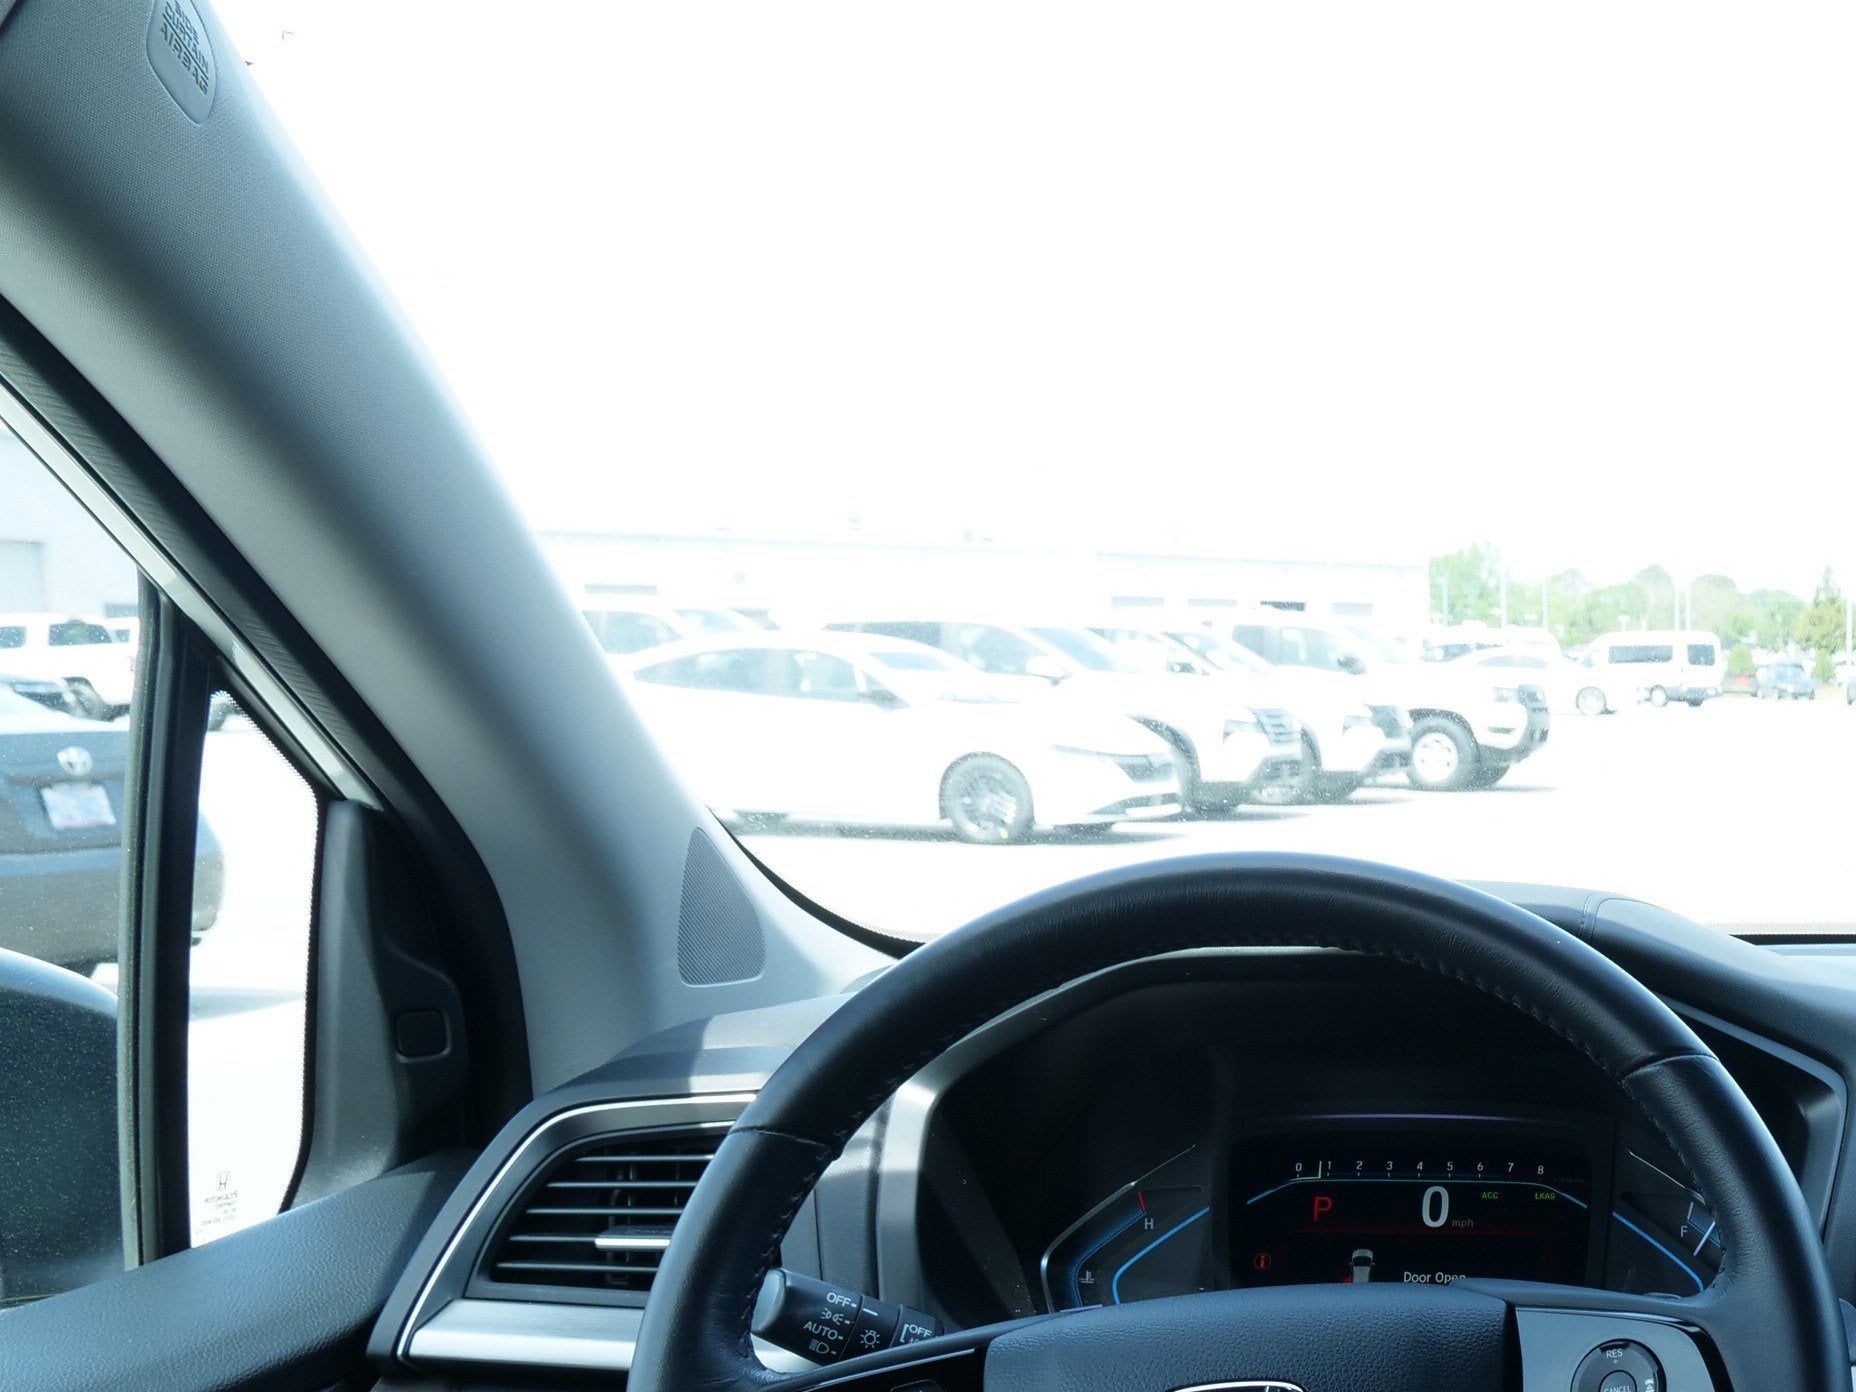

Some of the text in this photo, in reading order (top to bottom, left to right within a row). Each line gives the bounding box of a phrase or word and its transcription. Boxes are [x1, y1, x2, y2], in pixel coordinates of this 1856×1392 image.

[160, 22, 209, 96] AIRBAG
[1295, 1161, 1544, 1175] 0 1 2 3 4 5 6 7 8
[1481, 1192, 1499, 1200] ACC
[1534, 1192, 1556, 1200] LKAS
[1313, 1196, 1333, 1223] P
[1421, 1185, 1474, 1229] 0 mph
[1144, 1217, 1154, 1230] H
[1680, 1225, 1688, 1238] F
[1403, 1271, 1431, 1284] Door
[826, 1292, 852, 1308] OFF
[803, 1321, 838, 1340] AUTO
[909, 1324, 933, 1338] OFF
[1606, 1349, 1623, 1359] RES
